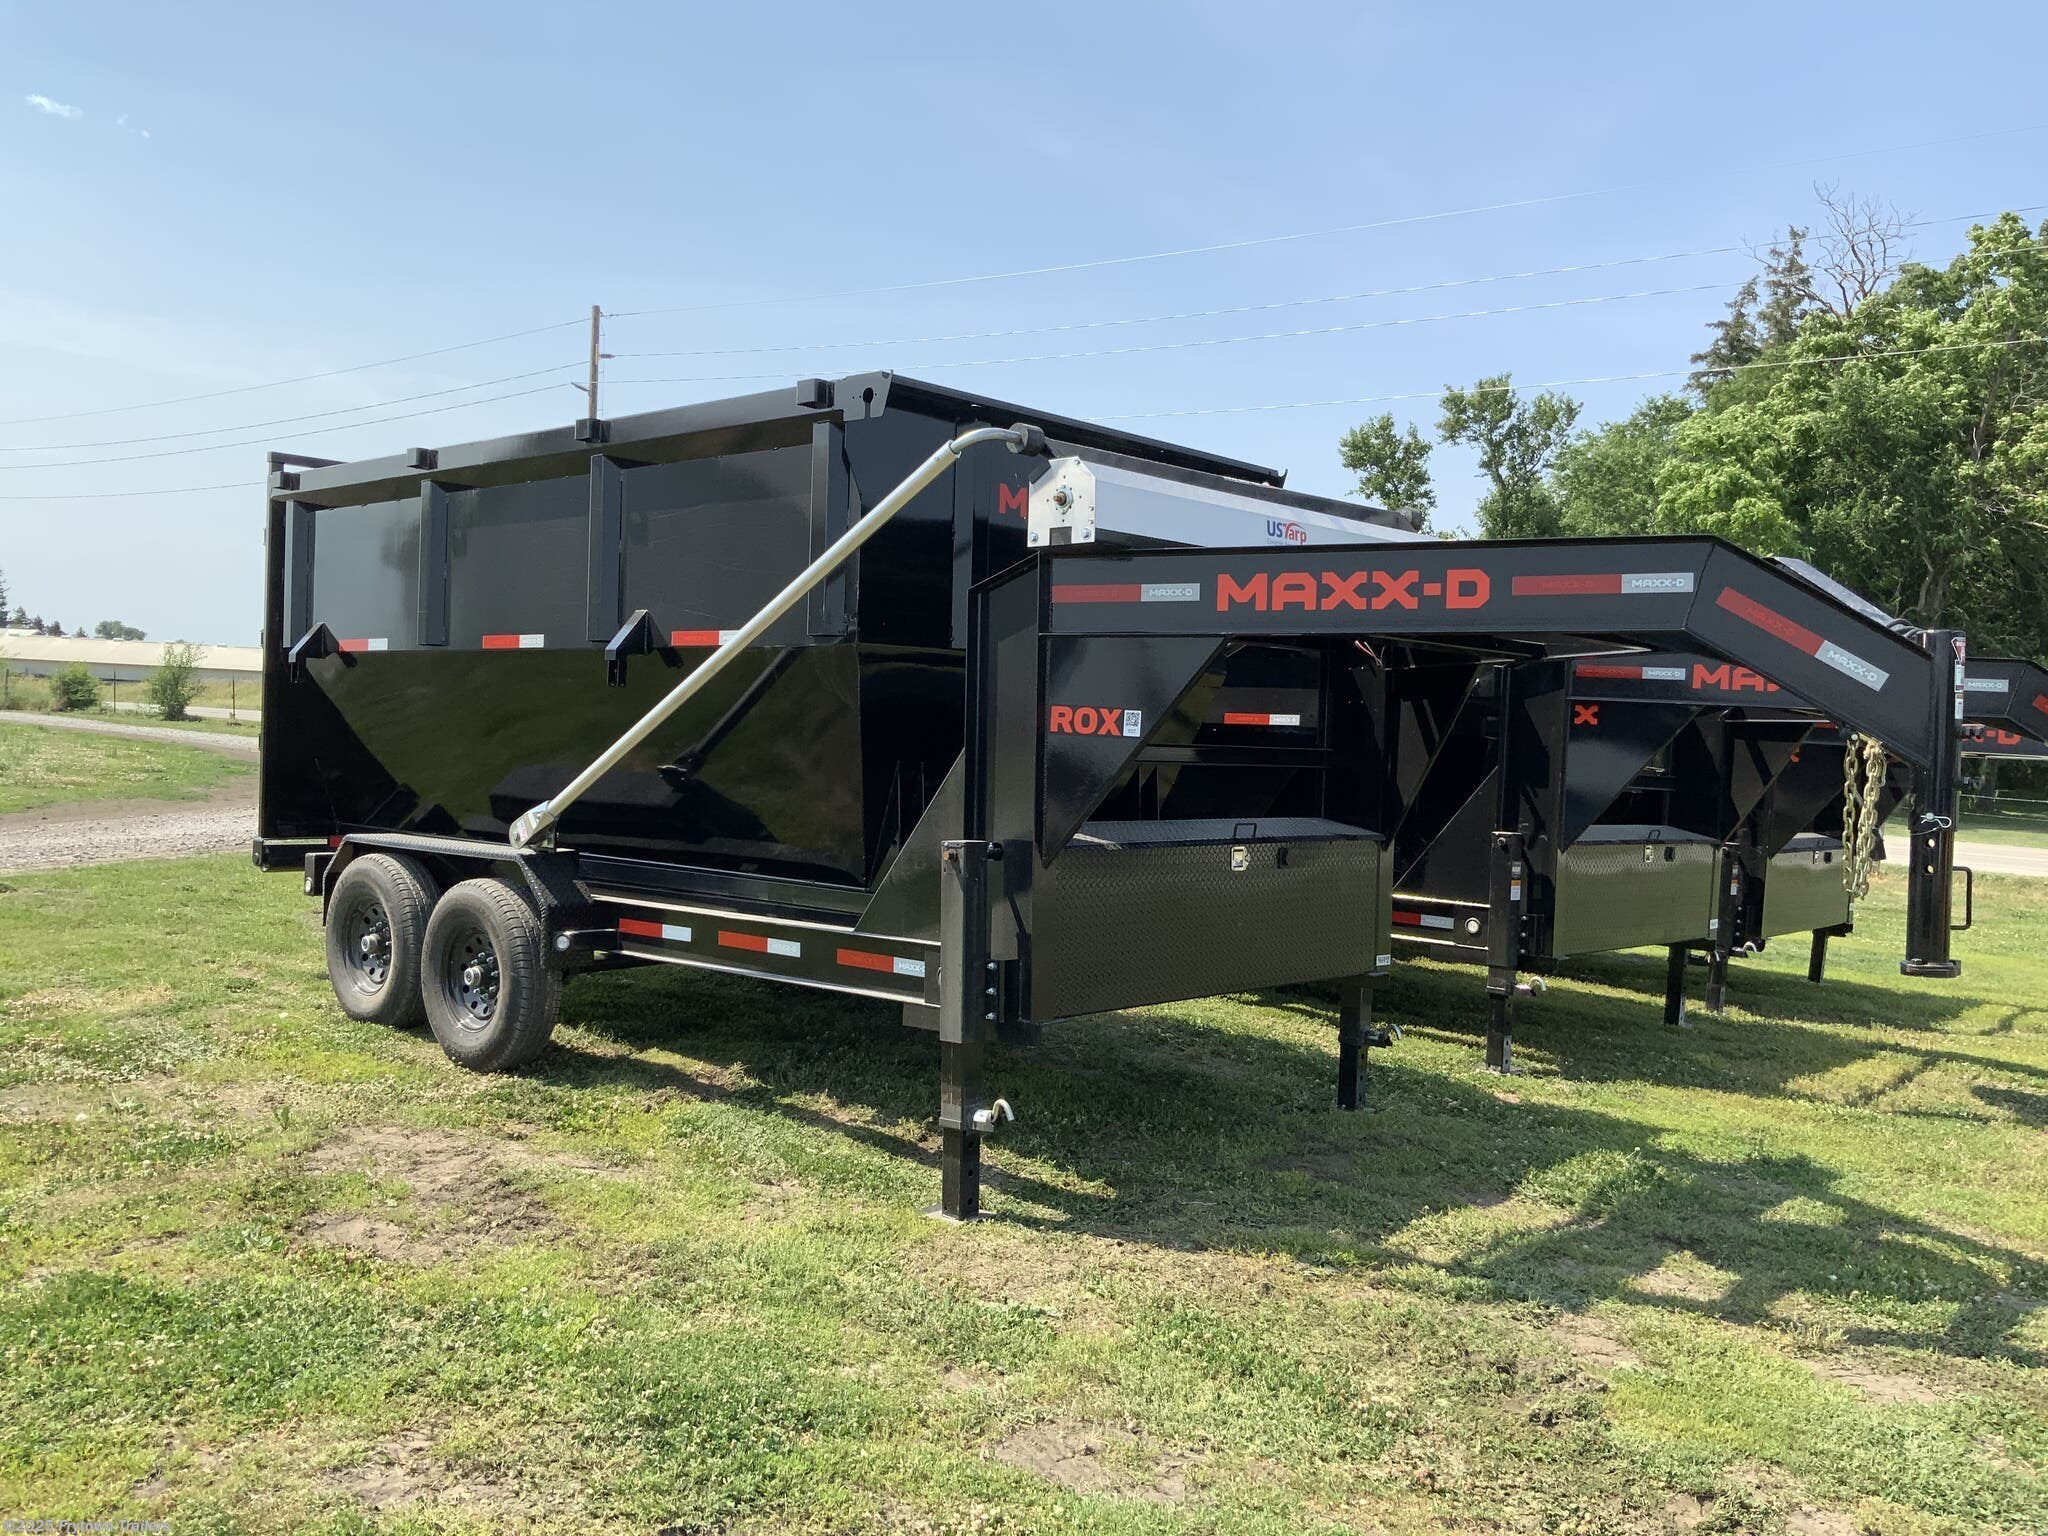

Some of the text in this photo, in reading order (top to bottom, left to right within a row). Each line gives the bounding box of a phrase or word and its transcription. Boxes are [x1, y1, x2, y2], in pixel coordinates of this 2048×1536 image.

[1631, 578, 1685, 588] MAXX-D
[1149, 588, 1193, 597] MAXX-D
[1216, 568, 1490, 611] MAXX-D
[1827, 649, 1878, 682] MAXX-D
[1648, 670, 1680, 678] MAXX-D
[1967, 681, 2002, 689] MAXX-D
[1049, 705, 1122, 736] ROX
